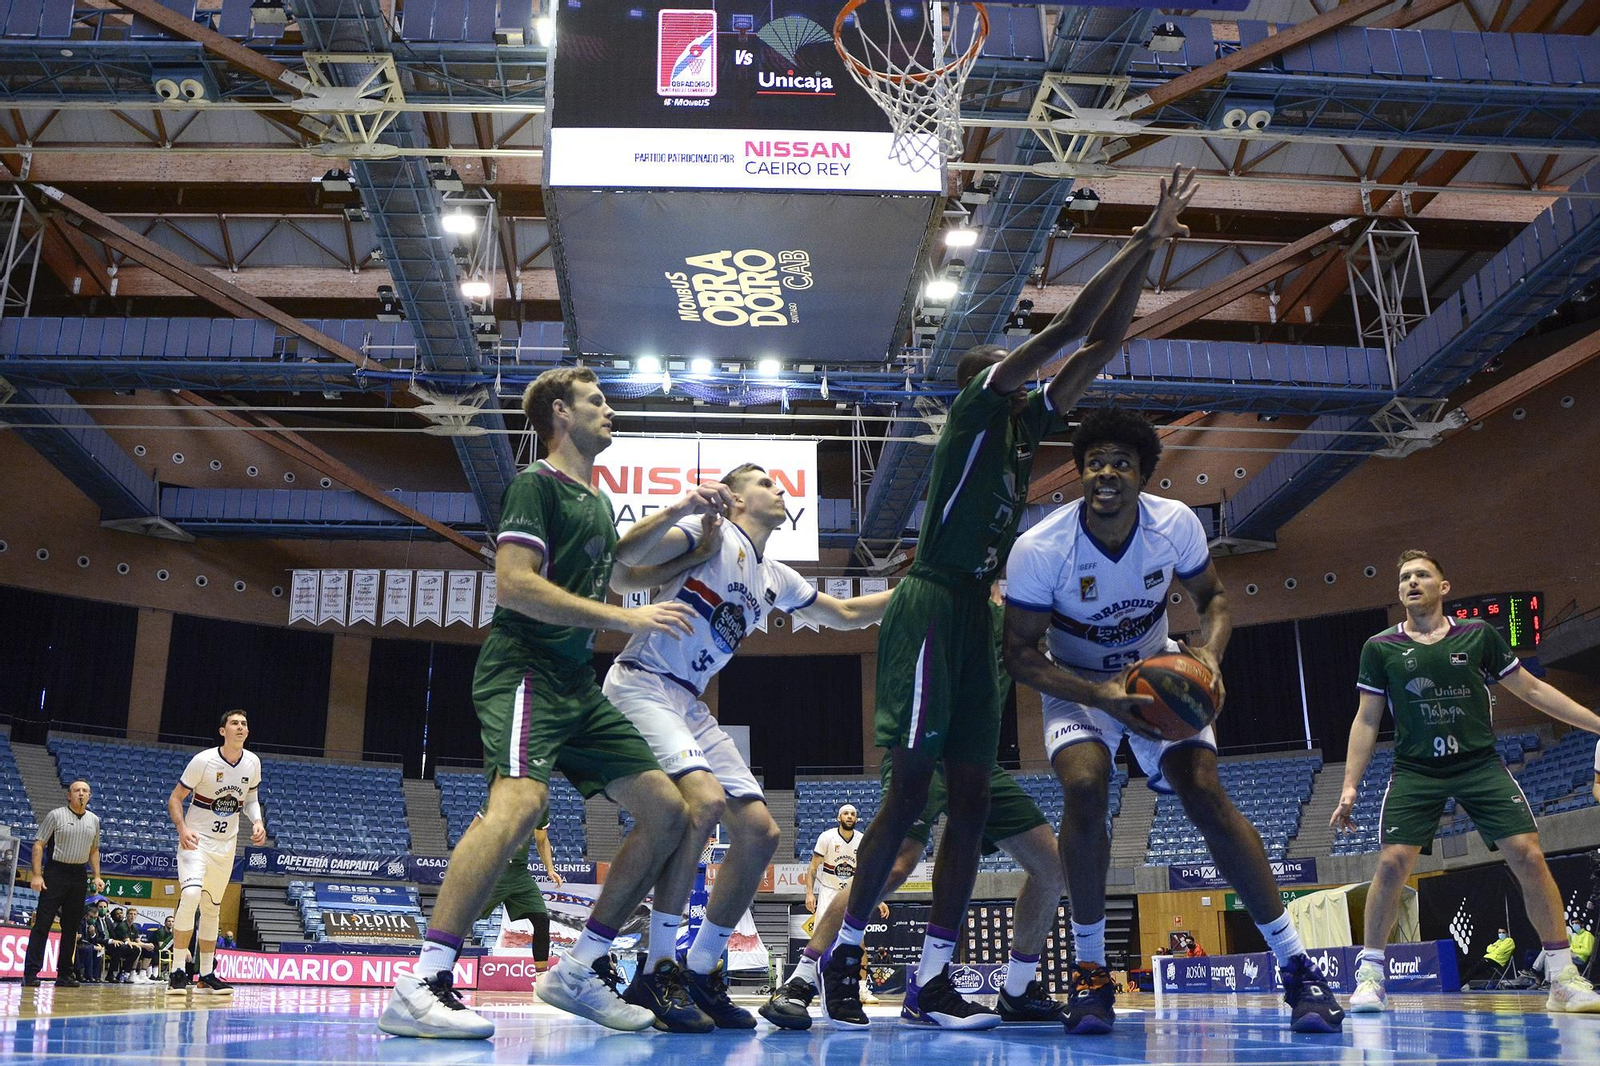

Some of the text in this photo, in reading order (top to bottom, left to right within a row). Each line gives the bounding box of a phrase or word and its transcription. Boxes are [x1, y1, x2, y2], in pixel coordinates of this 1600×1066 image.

[735, 49, 754, 66] Vs
[758, 69, 834, 92] Unicaja
[634, 153, 735, 163] PARTIDO PATROCINADO POR
[745, 141, 851, 158] NISSAN
[745, 160, 851, 176] CAEIRO REY
[778, 250, 813, 290] CAB
[665, 271, 701, 322] MONBUS
[684, 250, 749, 327] OBRA
[592, 465, 806, 498] NISSN
[1472, 607, 1479, 616] 3
[1487, 603, 1500, 615] 56
[1434, 684, 1472, 698] Unicaja
[1420, 701, 1466, 723] Málaga
[1433, 734, 1460, 757] 99
[211, 820, 228, 834] 32
[130, 854, 170, 868] FONTES
[276, 854, 380, 872] CAFETERÍA CARPANTA
[146, 910, 167, 918] PISTA
[329, 913, 411, 929] LA PEPITA
[214, 954, 354, 982] CONCESIONARIO
[1389, 956, 1419, 974] Carral
